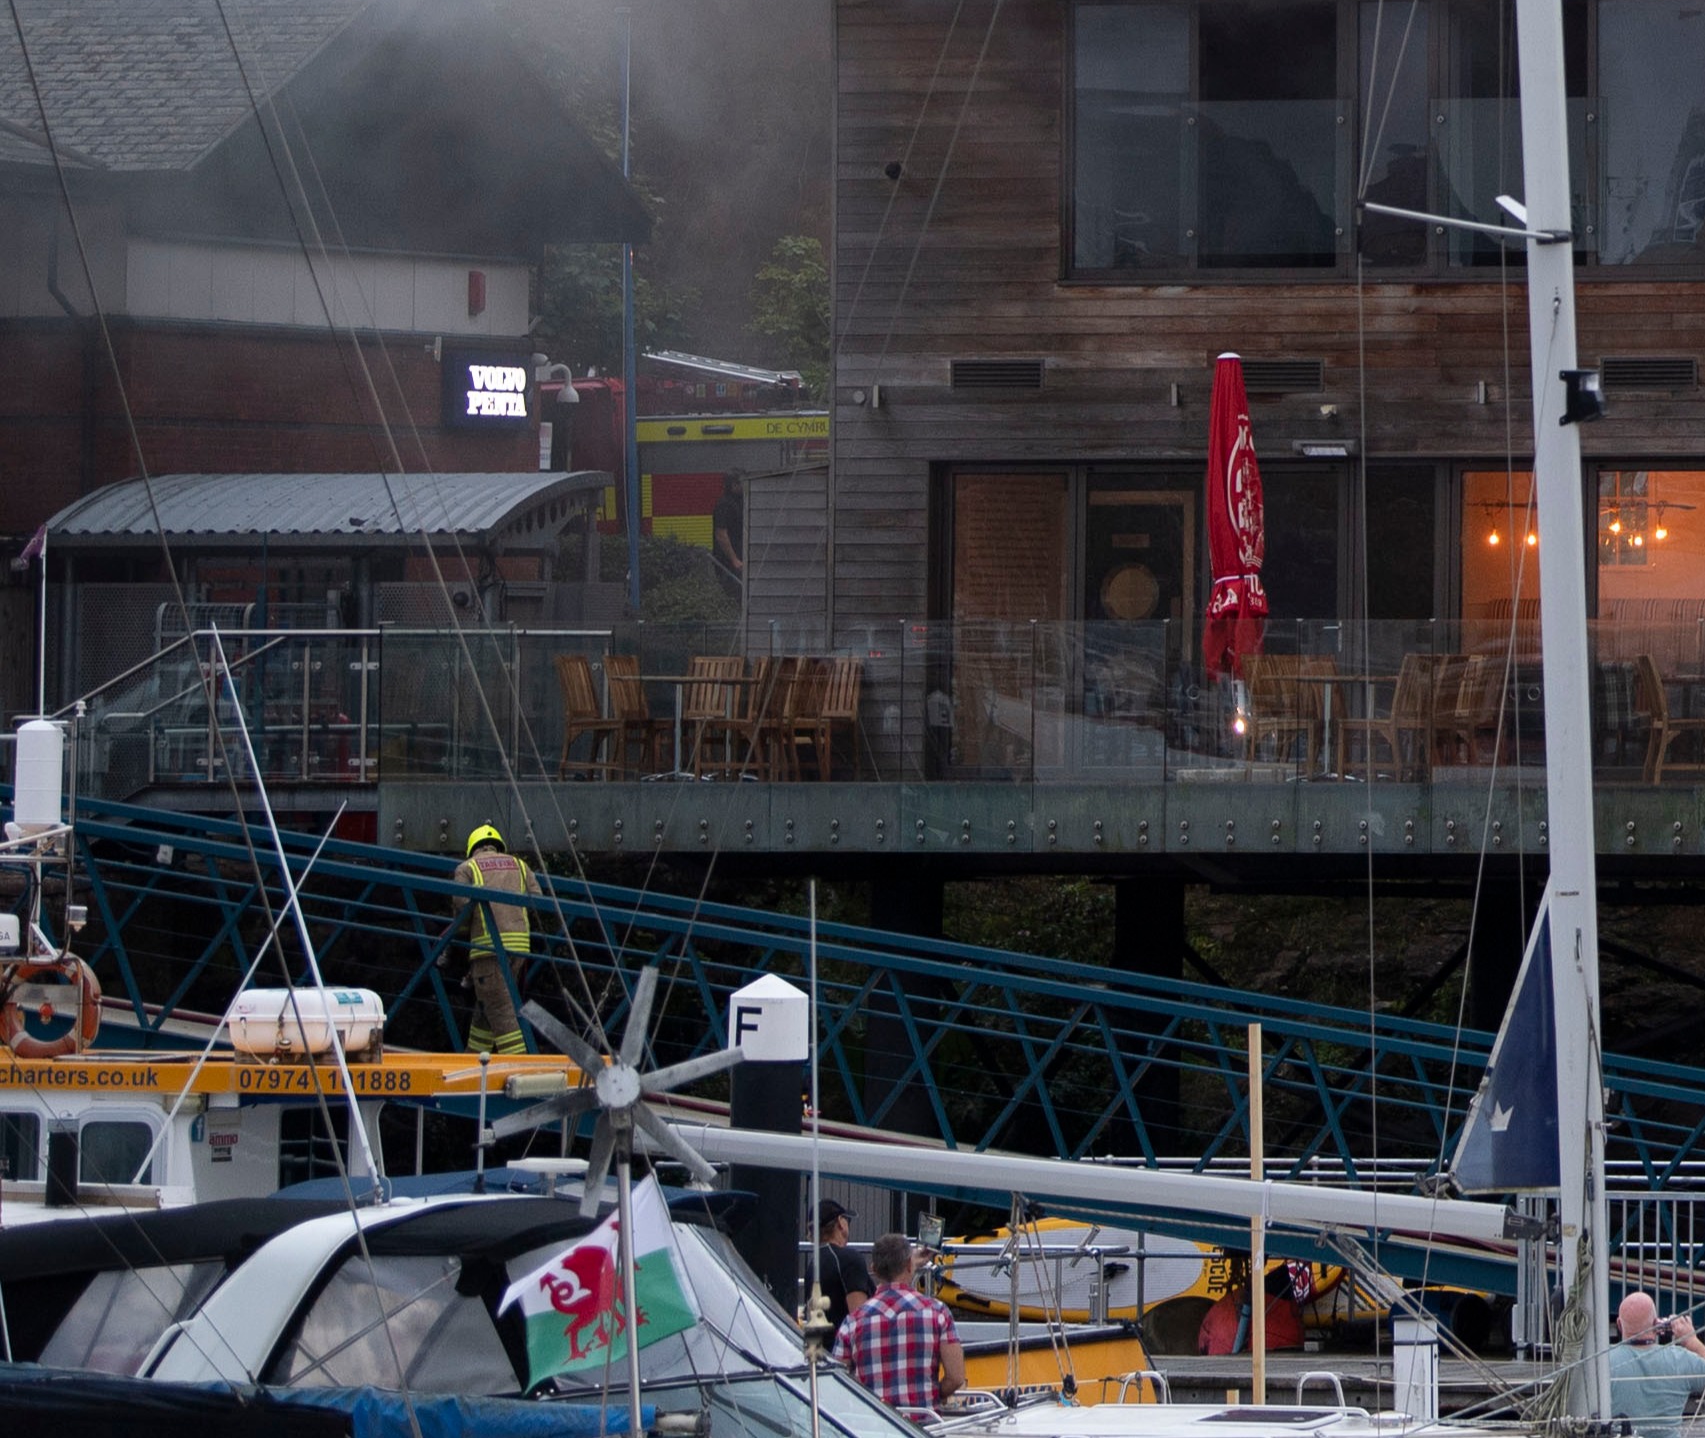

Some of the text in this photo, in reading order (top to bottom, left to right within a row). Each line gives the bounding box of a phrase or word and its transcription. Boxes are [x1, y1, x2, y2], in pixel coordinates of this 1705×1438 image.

[468, 365, 527, 392] VOLVO
[466, 390, 528, 417] PENTA
[766, 422, 783, 434] DE
[735, 1005, 762, 1047] F
[239, 1069, 309, 1088] 07974
[208, 1133, 239, 1146] ammo
